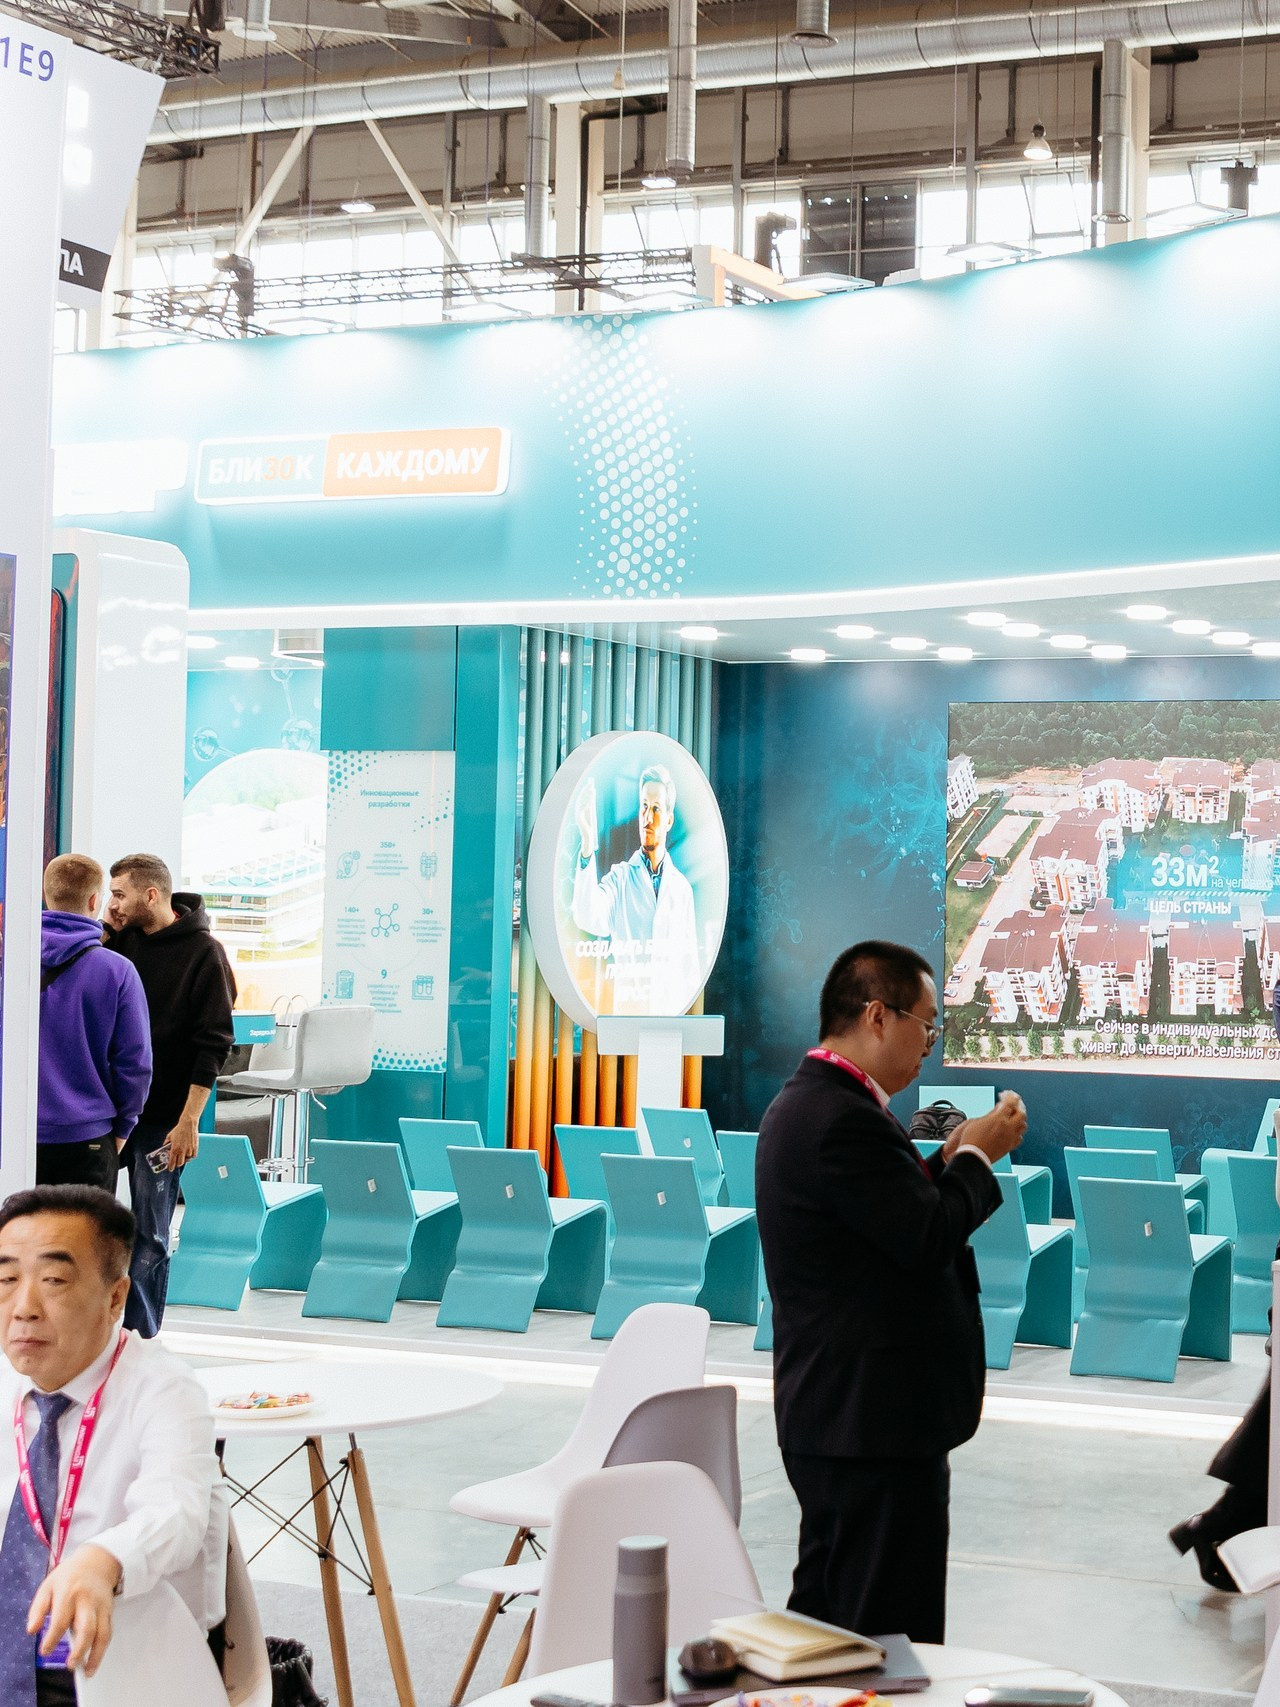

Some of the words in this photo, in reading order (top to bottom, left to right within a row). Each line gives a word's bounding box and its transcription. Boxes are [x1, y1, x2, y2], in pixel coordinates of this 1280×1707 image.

[338, 447, 488, 482] КАЖДОМУ
[1211, 878, 1224, 888] на
[1150, 901, 1181, 915] ЦЕЛЬ
[1183, 902, 1231, 914] СТРАНЫ
[381, 969, 387, 979] 9
[1094, 1019, 1139, 1034] Сейчас
[1142, 1024, 1149, 1034] в
[1152, 1025, 1258, 1040] индивидуальных
[1079, 1042, 1118, 1055] живет
[1120, 1043, 1136, 1056] до
[1139, 1045, 1194, 1059] четверти
[1197, 1046, 1263, 1059] населения
